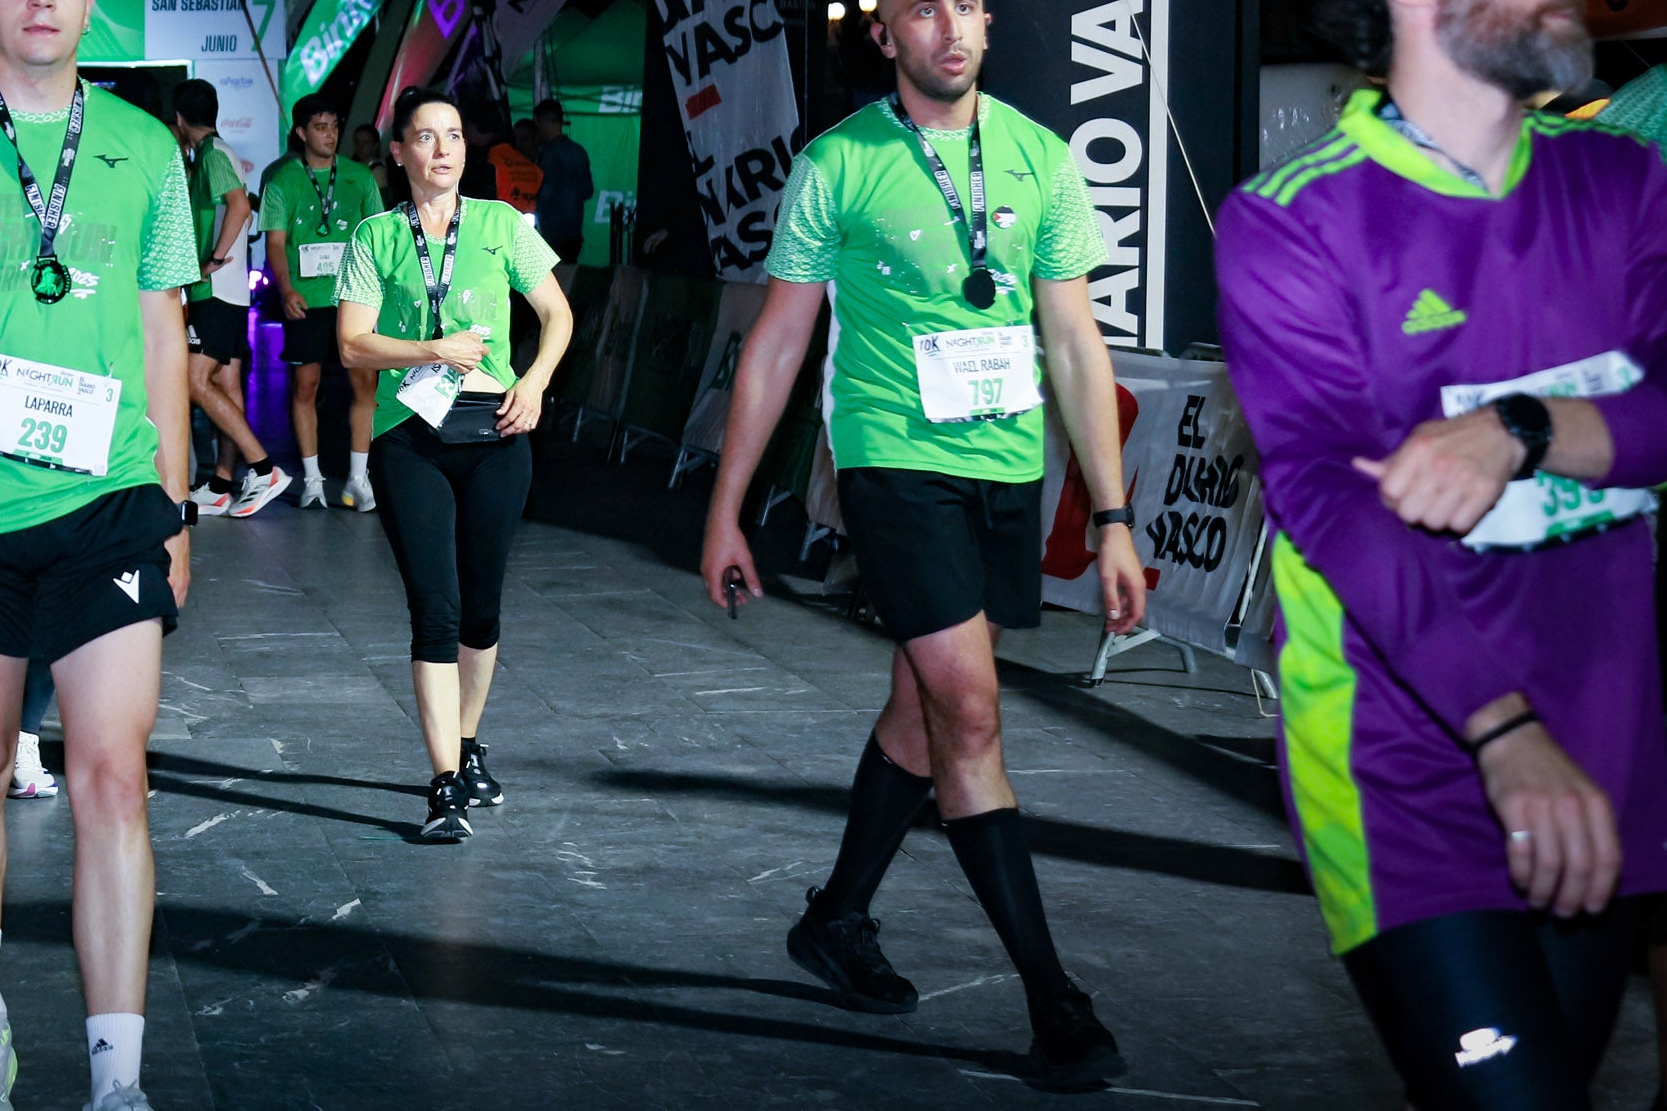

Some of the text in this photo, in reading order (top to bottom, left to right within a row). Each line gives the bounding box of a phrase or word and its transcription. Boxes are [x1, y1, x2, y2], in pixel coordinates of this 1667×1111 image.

[201, 35, 238, 53] JUNIO
[970, 170, 985, 212] FINISHER
[44, 183, 67, 230] FINISHER
[920, 335, 940, 352] 10K
[953, 358, 1011, 374] WAEL RABAH
[105, 387, 114, 403] 3
[967, 378, 1003, 406] 797
[25, 395, 74, 418] LAPARRA
[17, 418, 68, 453] 239
[1178, 394, 1206, 449] EL
[1146, 511, 1227, 573] VASCO
